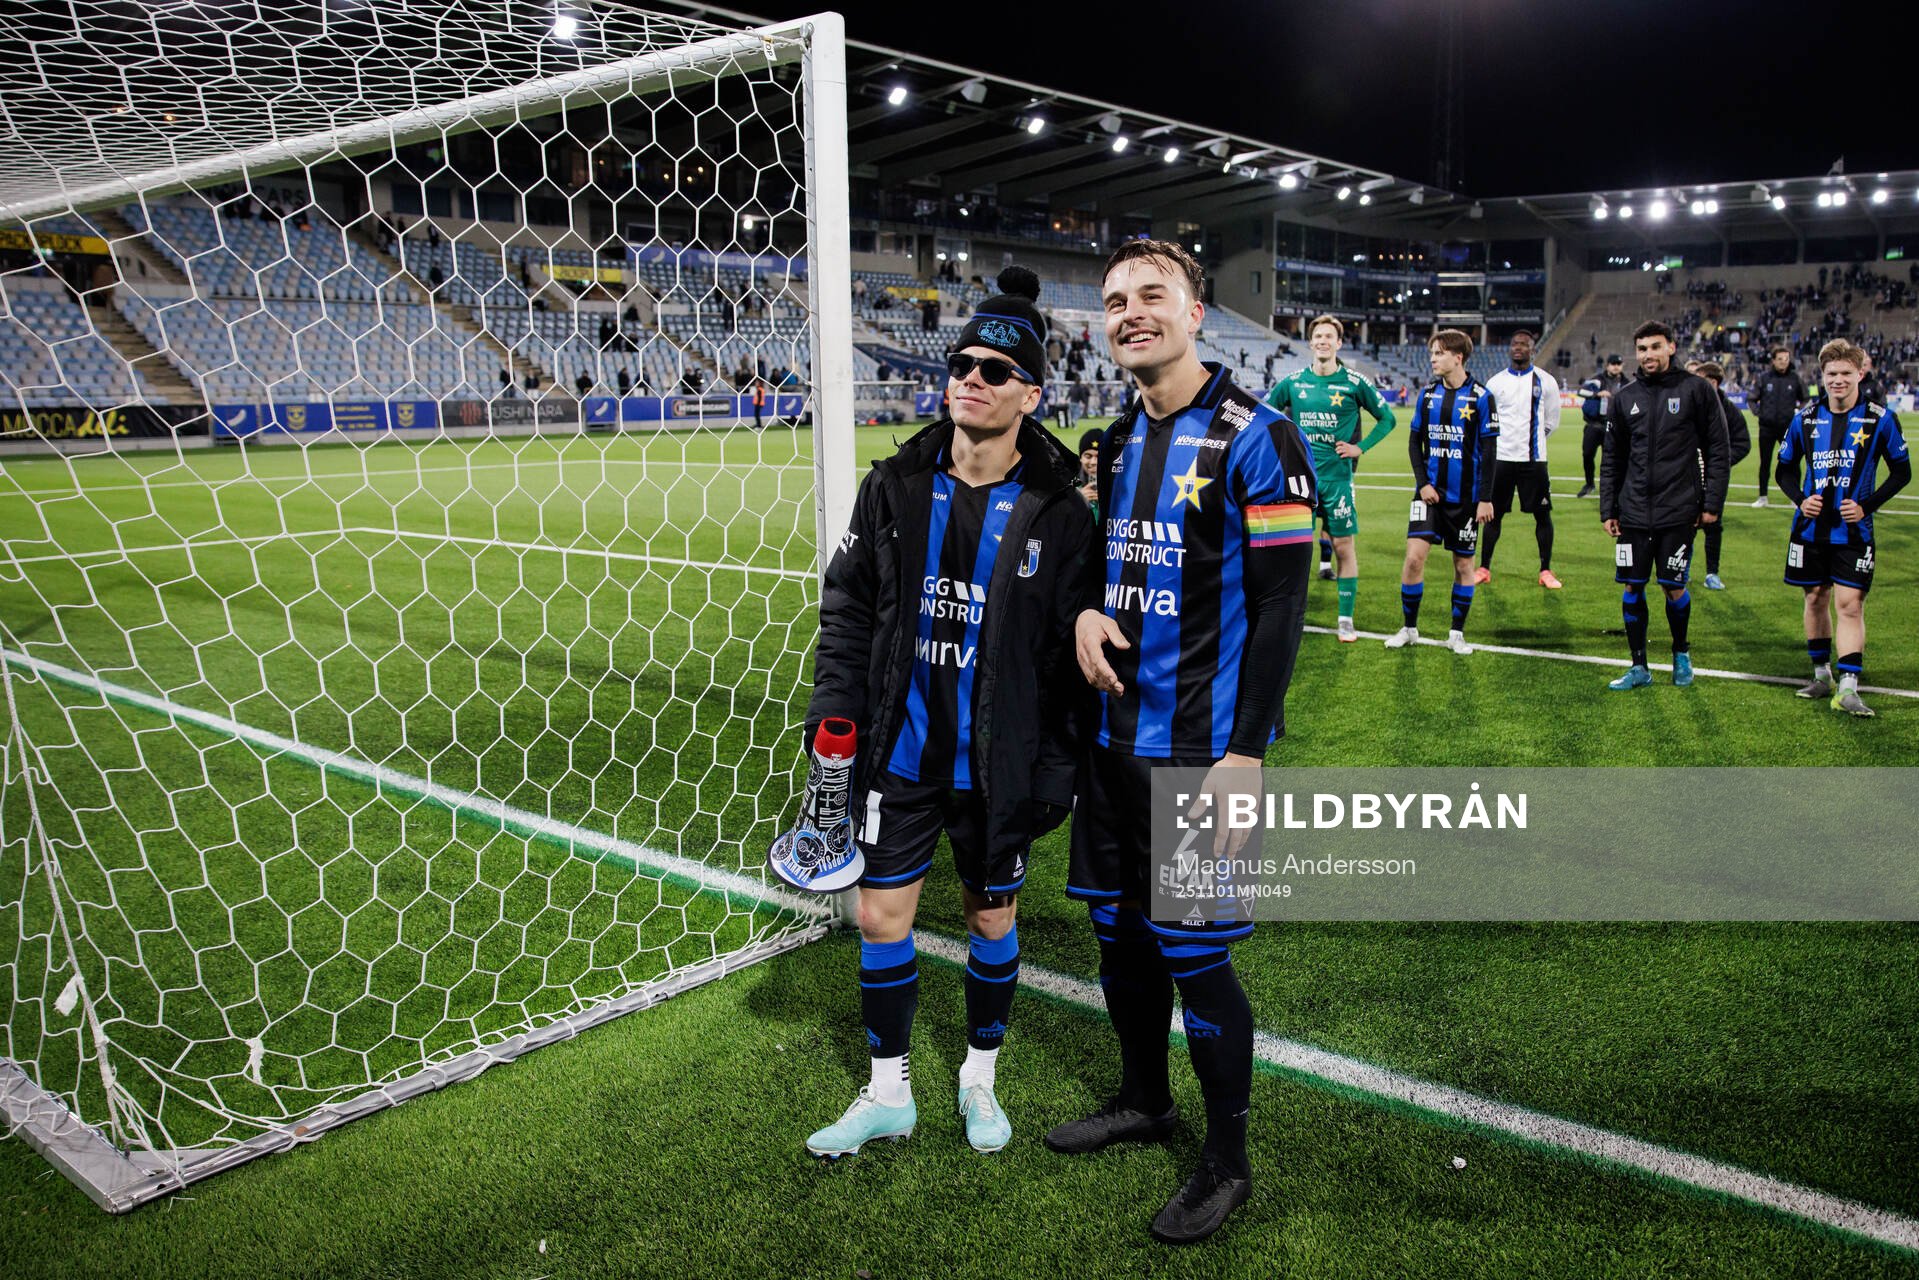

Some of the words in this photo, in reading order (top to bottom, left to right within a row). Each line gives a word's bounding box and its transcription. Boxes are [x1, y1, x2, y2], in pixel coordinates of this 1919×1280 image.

[1812, 450, 1835, 461] BYGG
[1106, 518, 1138, 538] BYGG
[1106, 541, 1187, 567] CONSTRUCT
[923, 576, 950, 596] GG
